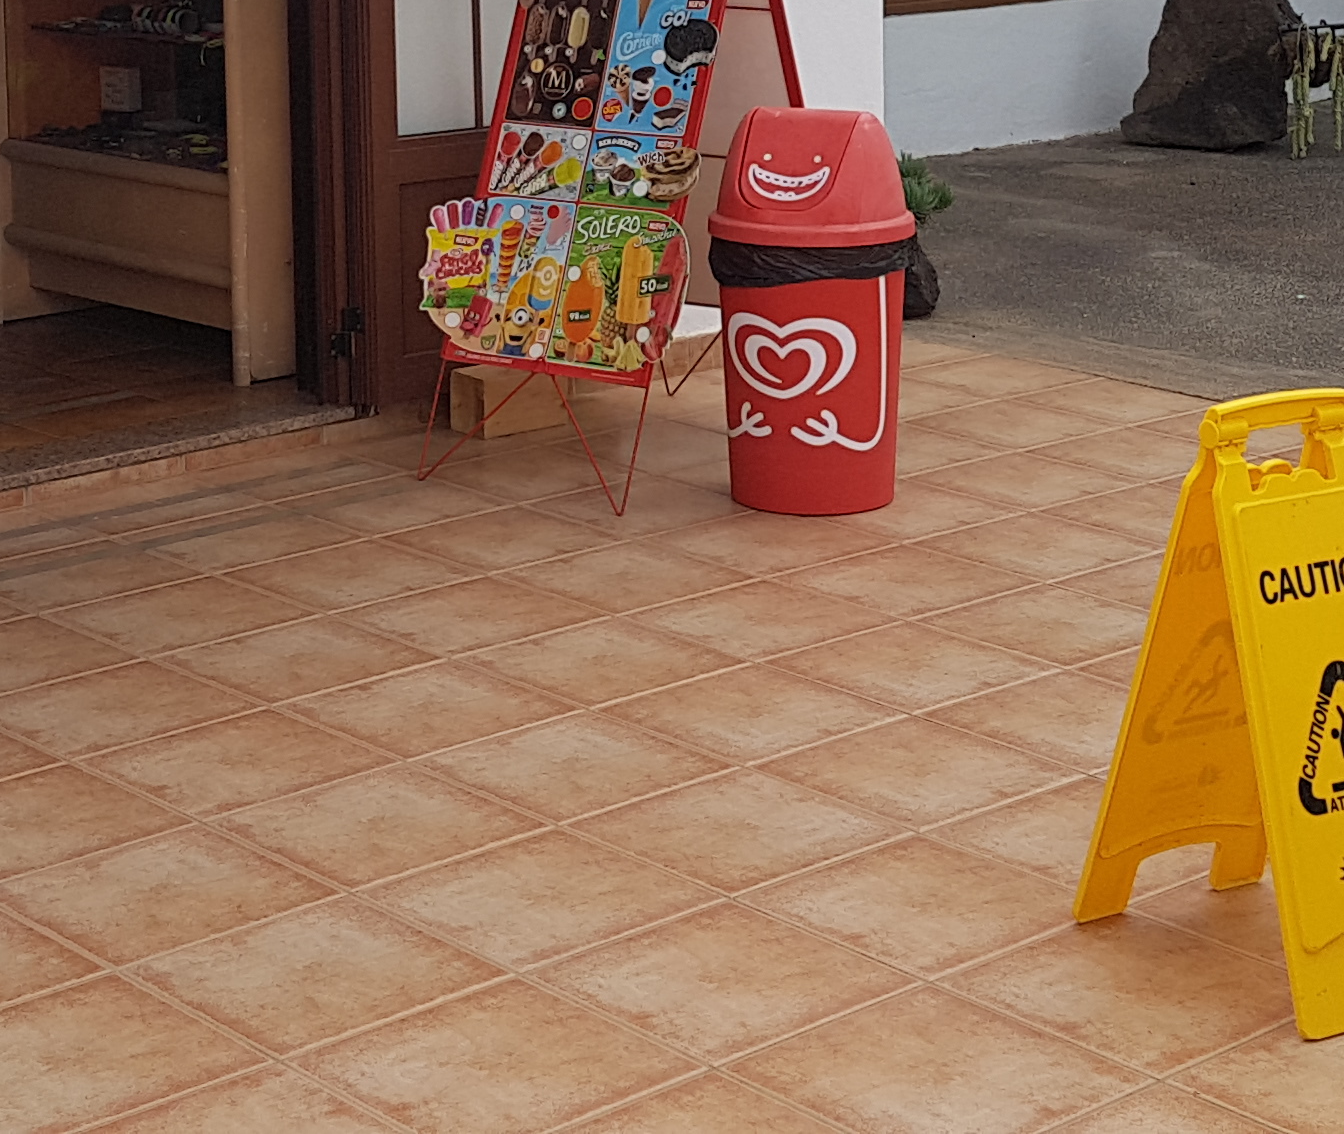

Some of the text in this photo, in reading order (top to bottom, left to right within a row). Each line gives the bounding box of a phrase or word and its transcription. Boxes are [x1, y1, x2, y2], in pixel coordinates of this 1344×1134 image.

[661, 10, 691, 27] GO!
[616, 31, 663, 61] Cornetto
[575, 215, 641, 244] SOLERO
[640, 279, 656, 293] 50
[1302, 694, 1331, 780] CAUTION
